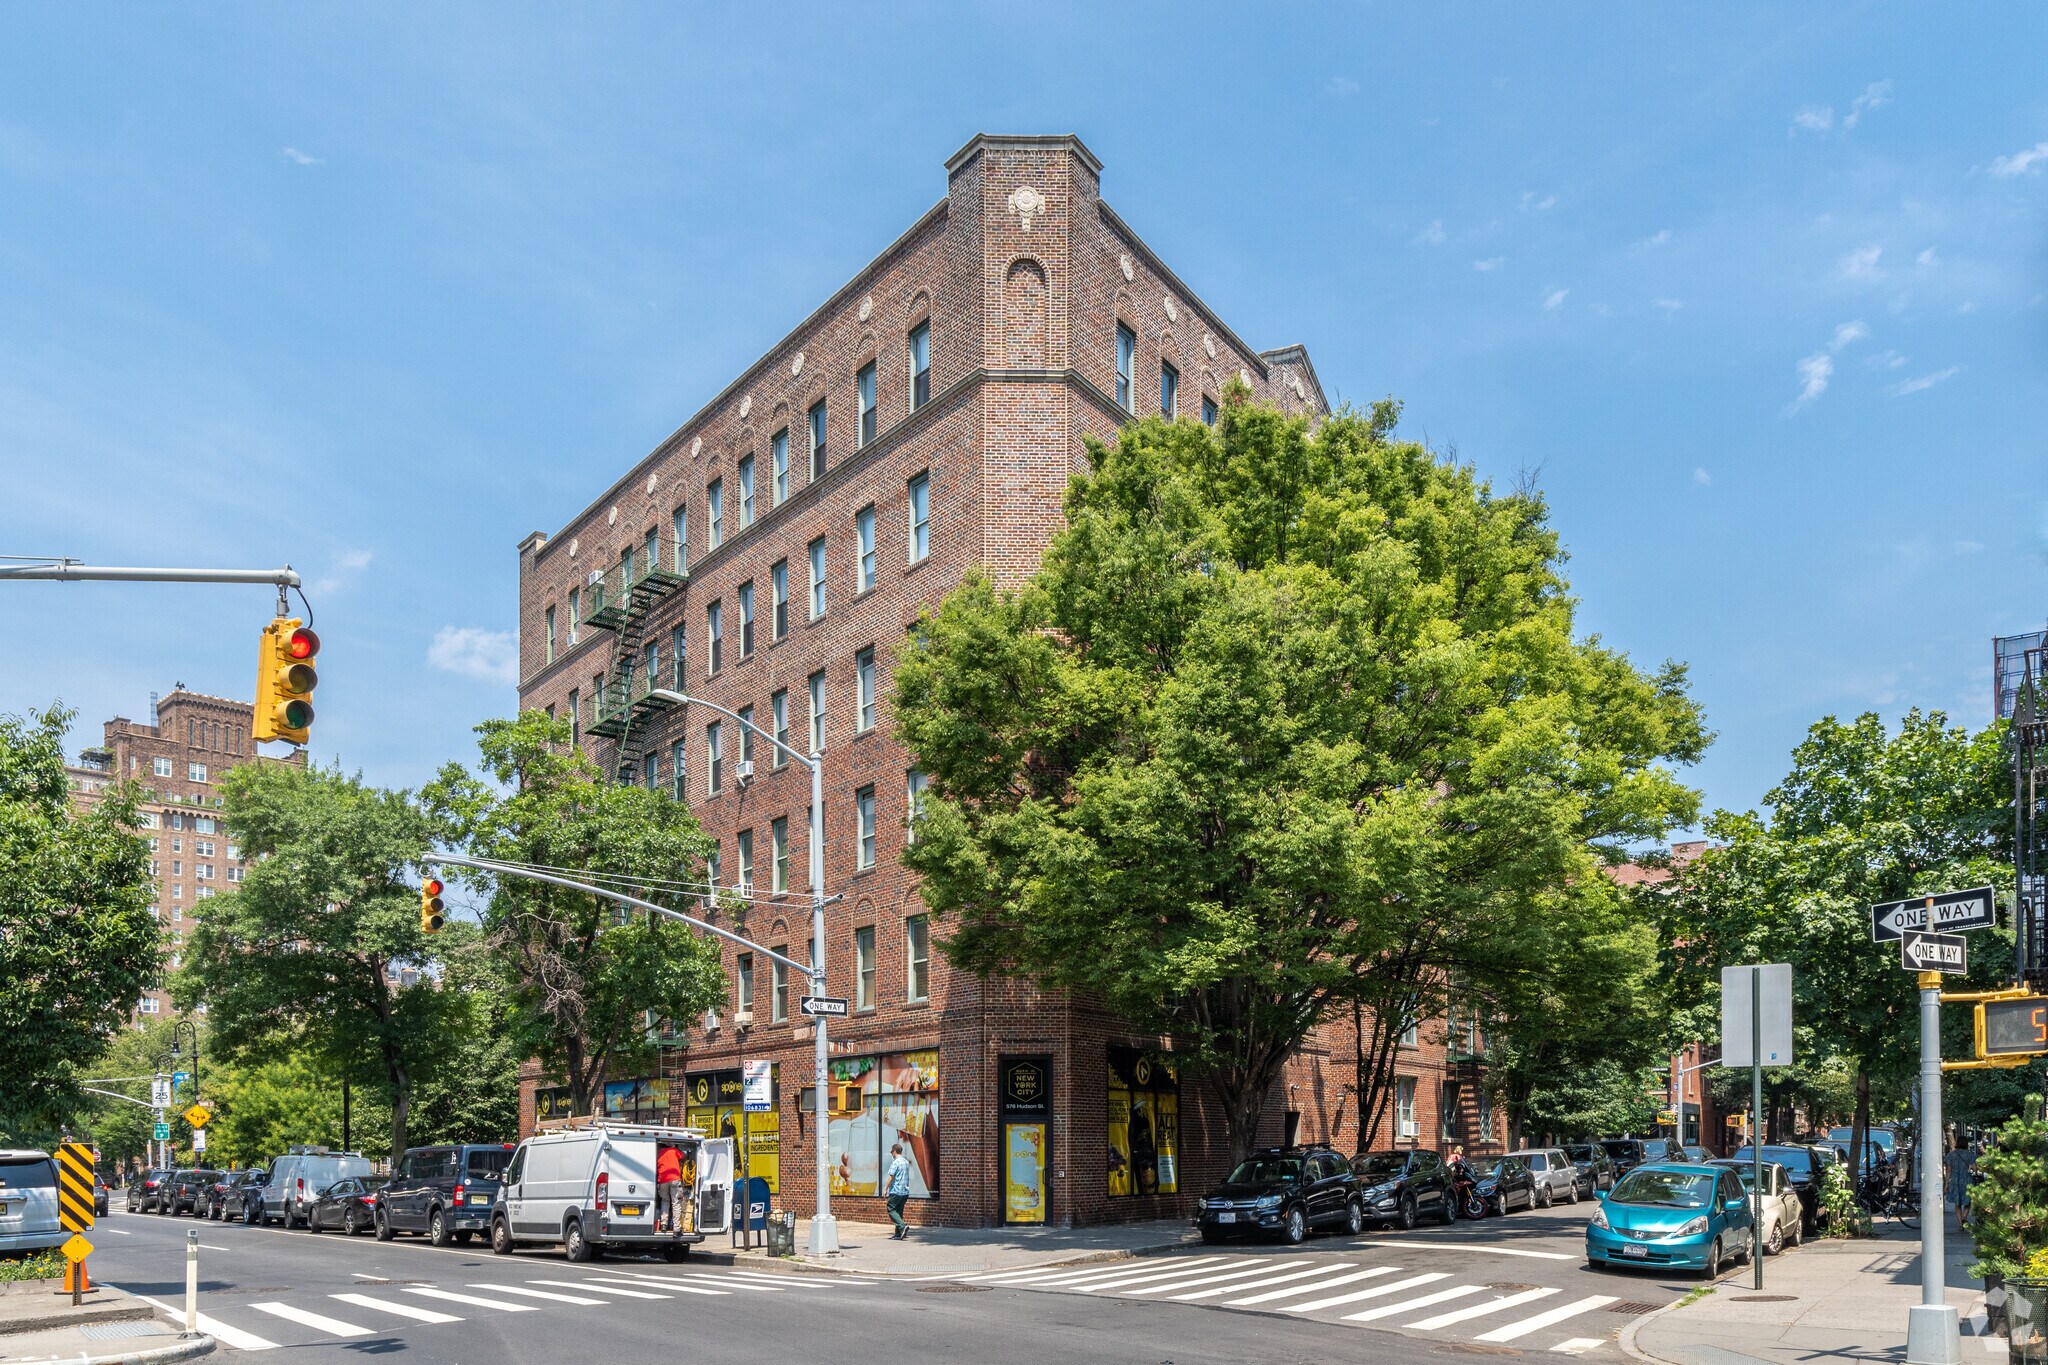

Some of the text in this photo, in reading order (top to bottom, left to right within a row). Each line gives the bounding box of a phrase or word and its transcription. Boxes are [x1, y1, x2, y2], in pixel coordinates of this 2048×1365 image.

[1894, 902, 1975, 928] ONE WAY
[1915, 944, 1958, 962] ONE WAY
[810, 1002, 842, 1011] ONE WAY
[2032, 1008, 2047, 1042] 5
[829, 1042, 835, 1052] W
[847, 1042, 855, 1053] ST
[155, 1092, 168, 1100] 25
[1158, 1115, 1176, 1130] ALL
[750, 1133, 779, 1143] ALL REAL
